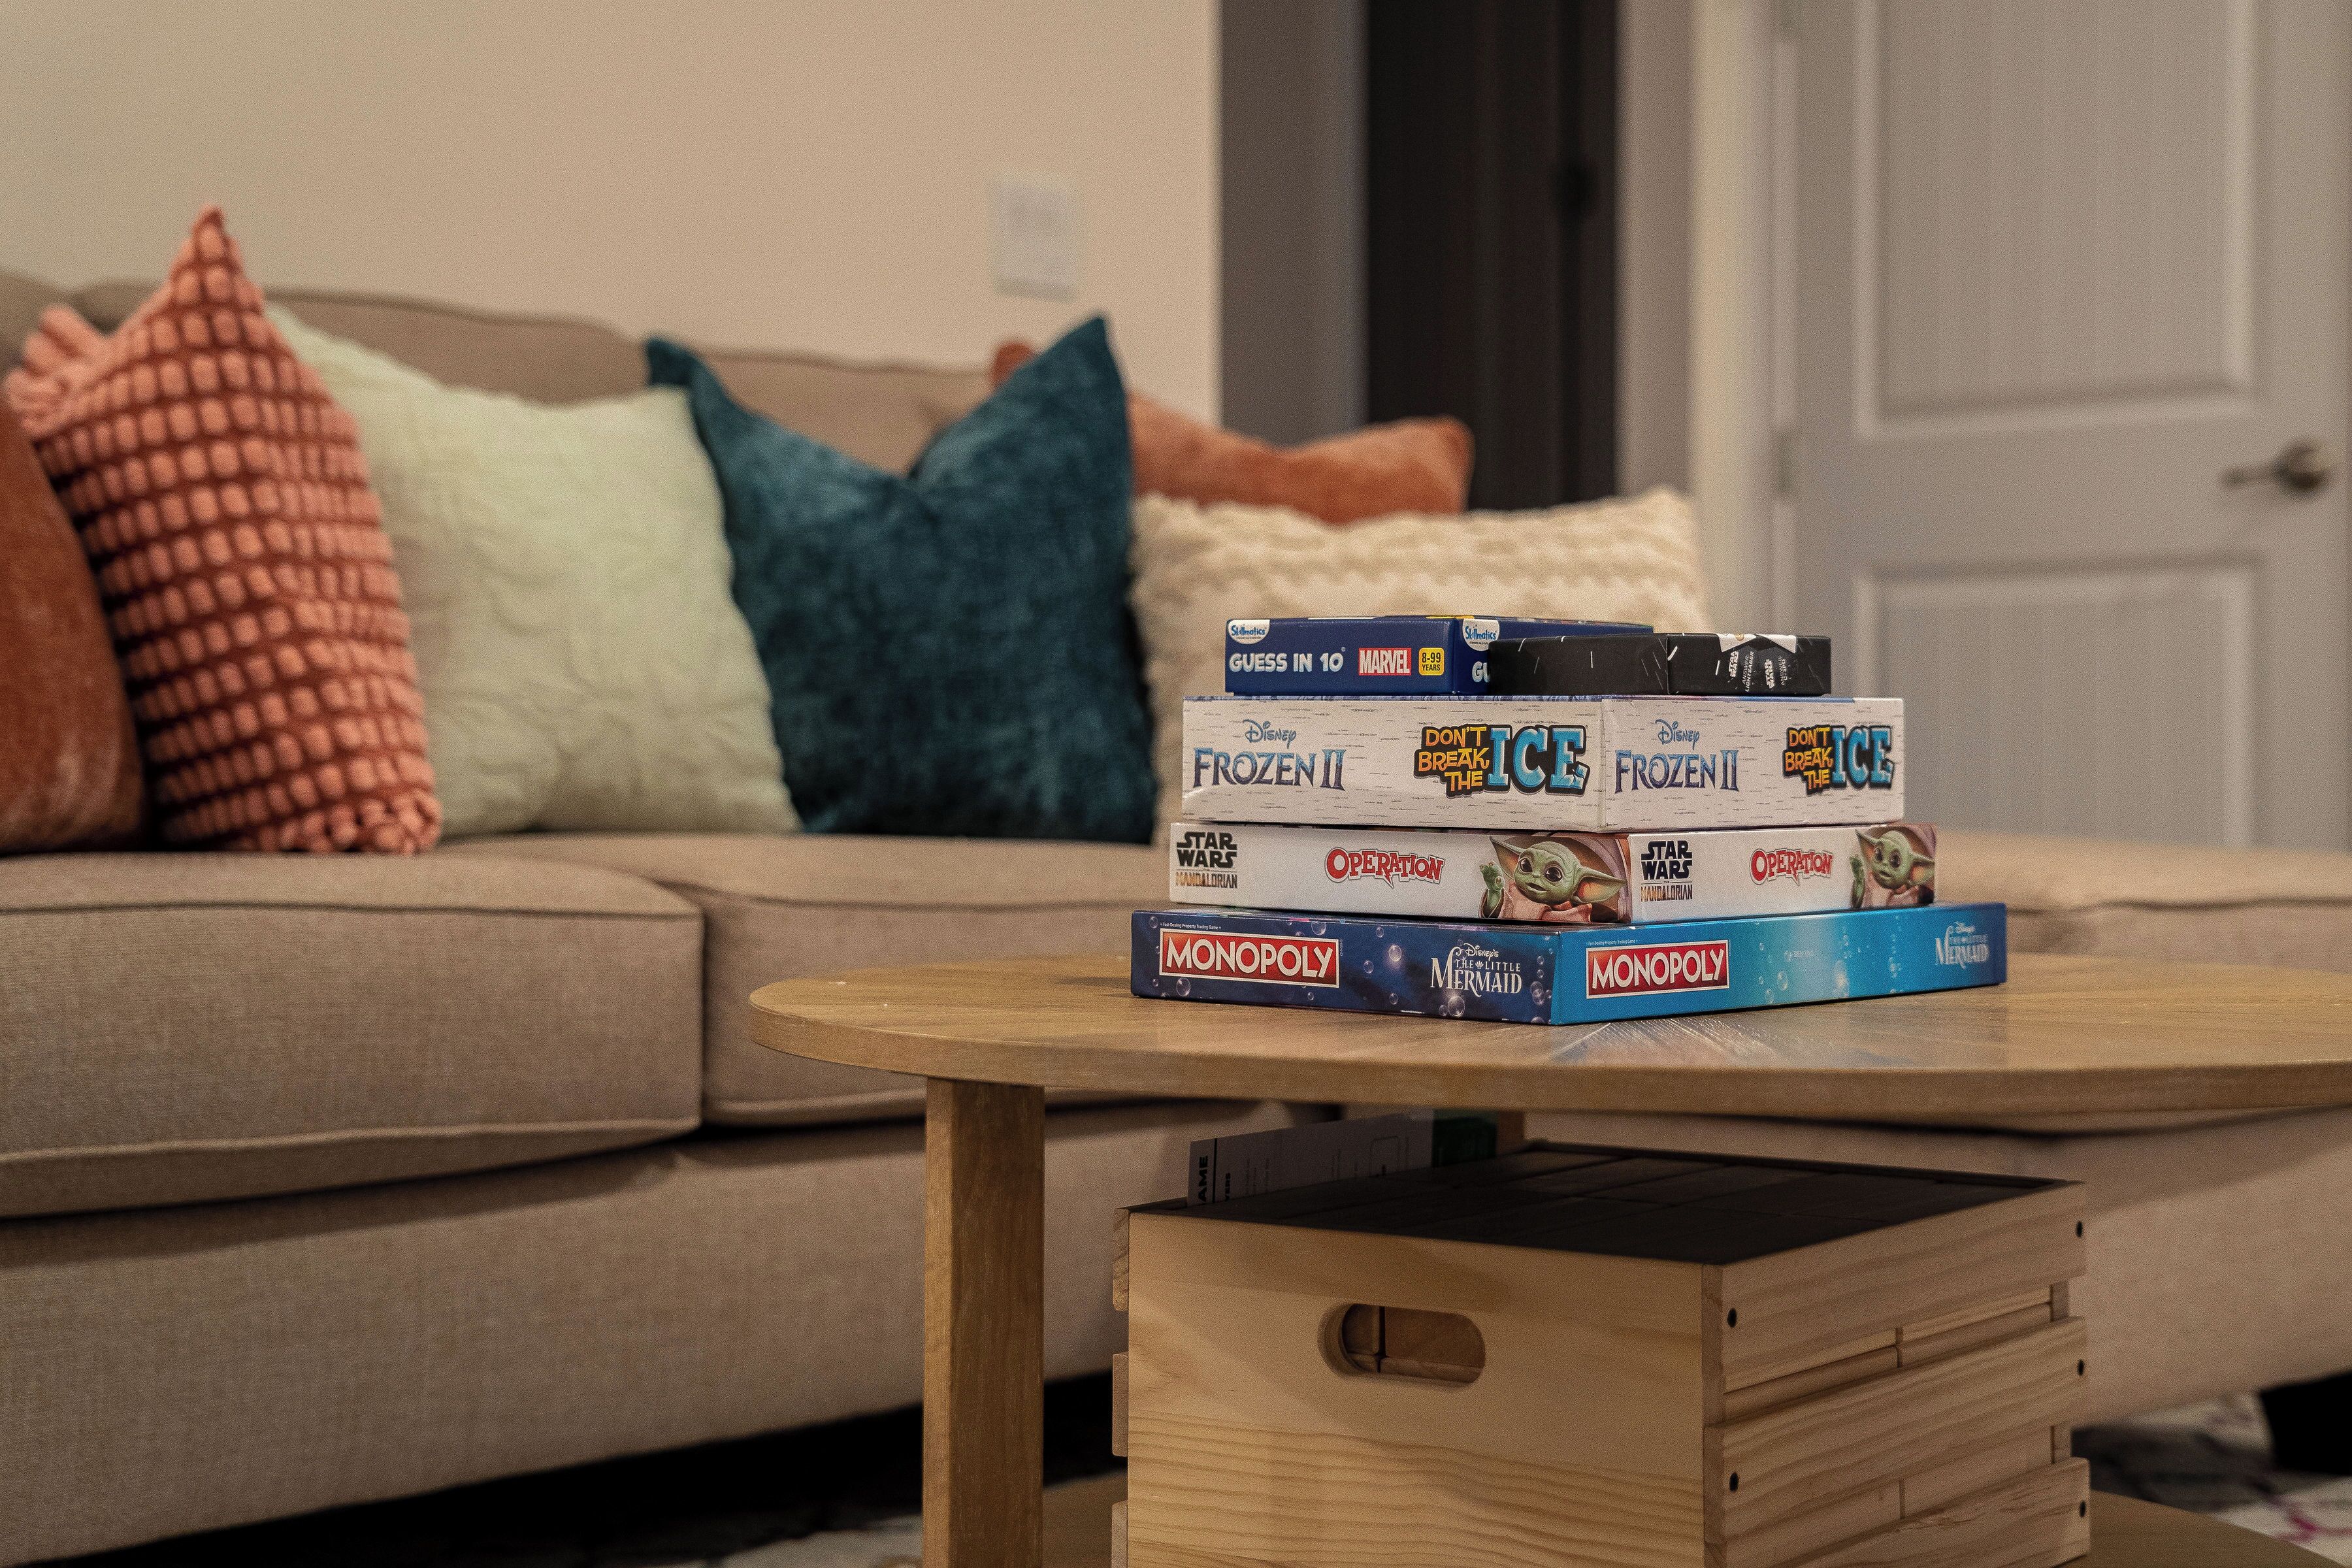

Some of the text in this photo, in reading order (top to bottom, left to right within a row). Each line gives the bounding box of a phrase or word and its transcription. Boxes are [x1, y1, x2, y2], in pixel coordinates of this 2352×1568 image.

[1465, 625, 1497, 640] Skillmatics
[1229, 653, 1344, 672] GUESS IN 10
[1360, 650, 1411, 674] MARVEL
[1422, 652, 1441, 663] 8-99
[1745, 651, 1754, 693] LIGHTSABER
[1242, 719, 1297, 749] Disney
[1425, 726, 1487, 747] DON'T
[1655, 719, 1700, 750] Disney
[1789, 727, 1830, 747] DON'T
[1418, 747, 1490, 772] BREAK
[1488, 727, 1588, 789] ICE
[1785, 747, 1834, 772] BREAK
[1832, 727, 1894, 784] ICE
[1193, 747, 1347, 791] FROZEN II
[1614, 749, 1739, 794] FROZEN II
[1803, 769, 1829, 790] THE
[1445, 770, 1483, 792] THE
[1177, 831, 1237, 851] STAR
[1641, 840, 1692, 860] STAR
[1177, 849, 1237, 868] WARS
[1326, 848, 1445, 885] OPERATION
[1641, 860, 1692, 880] WARS
[1751, 849, 1833, 884] OPERATION
[1176, 872, 1237, 889] MANDALORIAN
[1641, 885, 1692, 902] MANDALORIAN
[1166, 937, 1333, 978] MONOPOLY
[1463, 943, 1499, 961] Disney's
[1430, 946, 1522, 997] MERMAID
[1455, 959, 1521, 972] THE LITTLE
[1592, 949, 1724, 989] MONOPOLY
